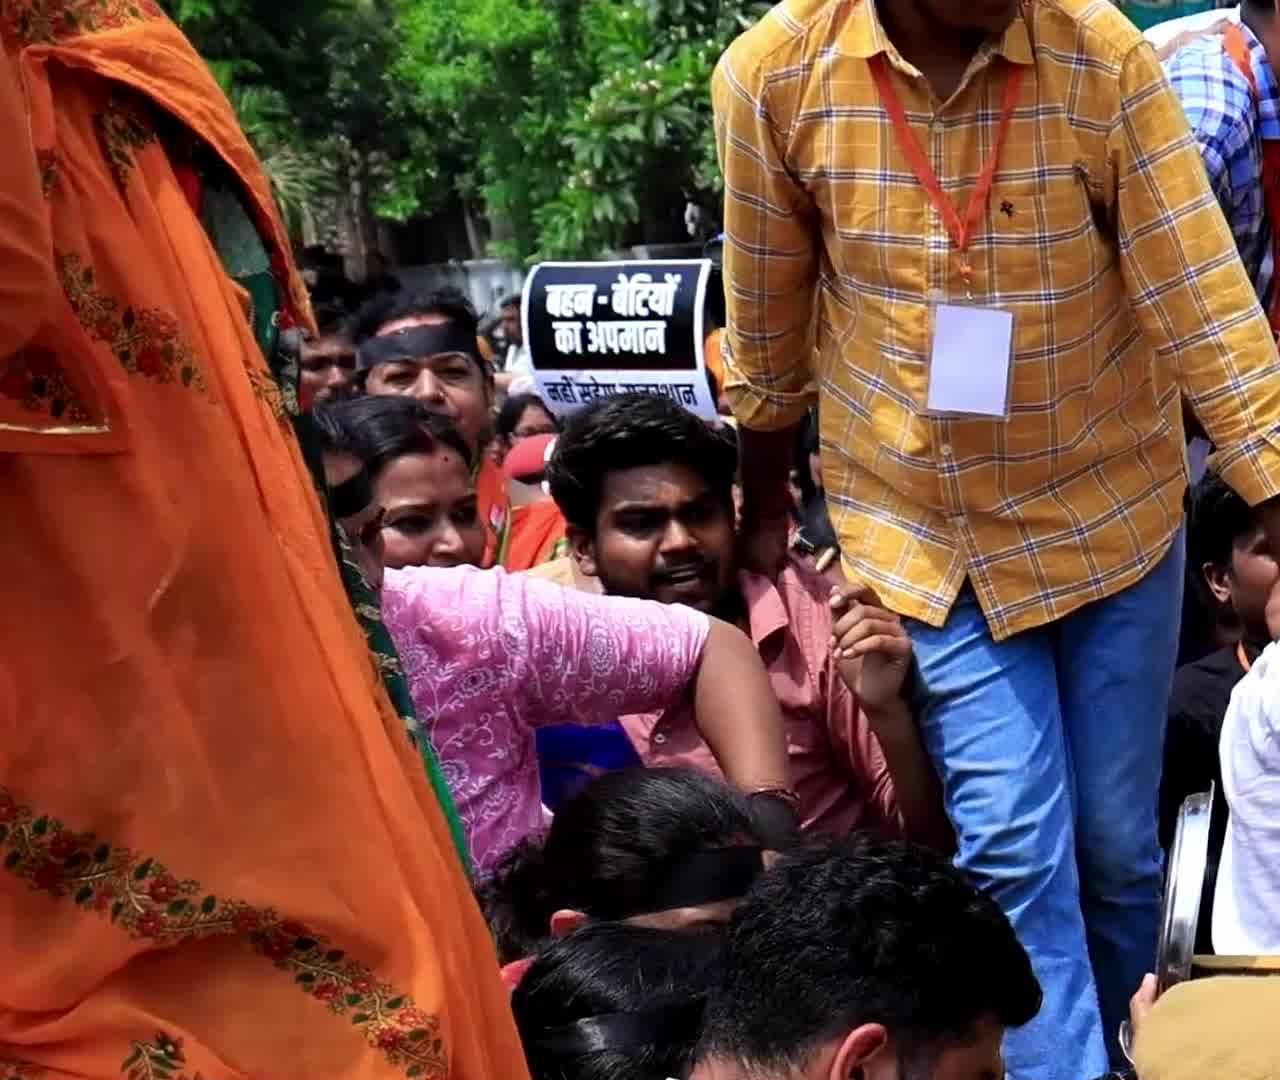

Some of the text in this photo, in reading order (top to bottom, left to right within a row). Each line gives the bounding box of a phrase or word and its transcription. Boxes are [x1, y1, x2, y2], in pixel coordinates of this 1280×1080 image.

[545, 284, 597, 317] बहन
[611, 273, 682, 316] बेटियों
[552, 320, 667, 354] का अपमान
[543, 375, 576, 402] नहीं
